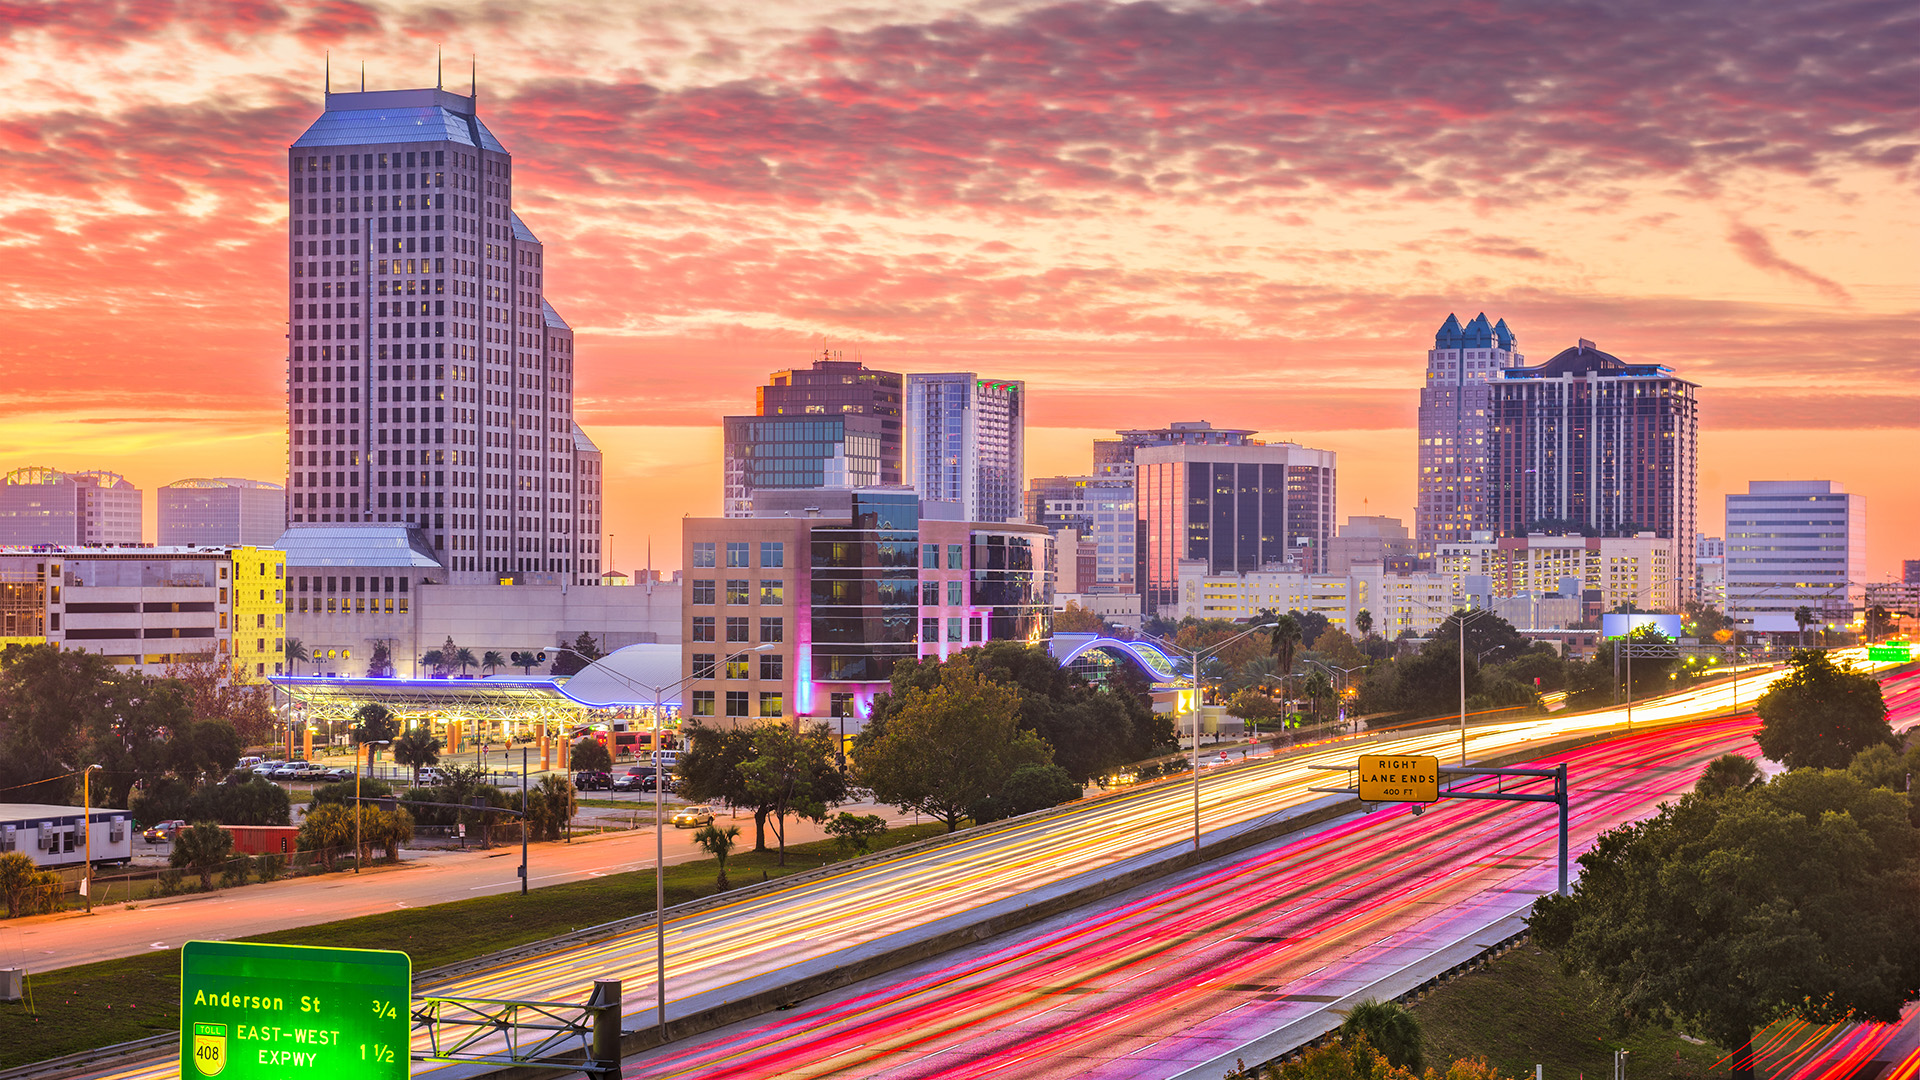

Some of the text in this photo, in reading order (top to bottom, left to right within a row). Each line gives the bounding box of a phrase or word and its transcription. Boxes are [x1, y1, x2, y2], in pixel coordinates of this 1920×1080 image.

[1379, 761, 1417, 769] RIGHT
[1362, 775, 1435, 783] LANE ENDS
[194, 989, 283, 1010] Anderson
[300, 995, 320, 1013] St
[200, 1026, 221, 1035] TOLL
[237, 1025, 340, 1045] EAST-WEST
[196, 1046, 219, 1060] 408
[258, 1049, 317, 1068] EXPWY
